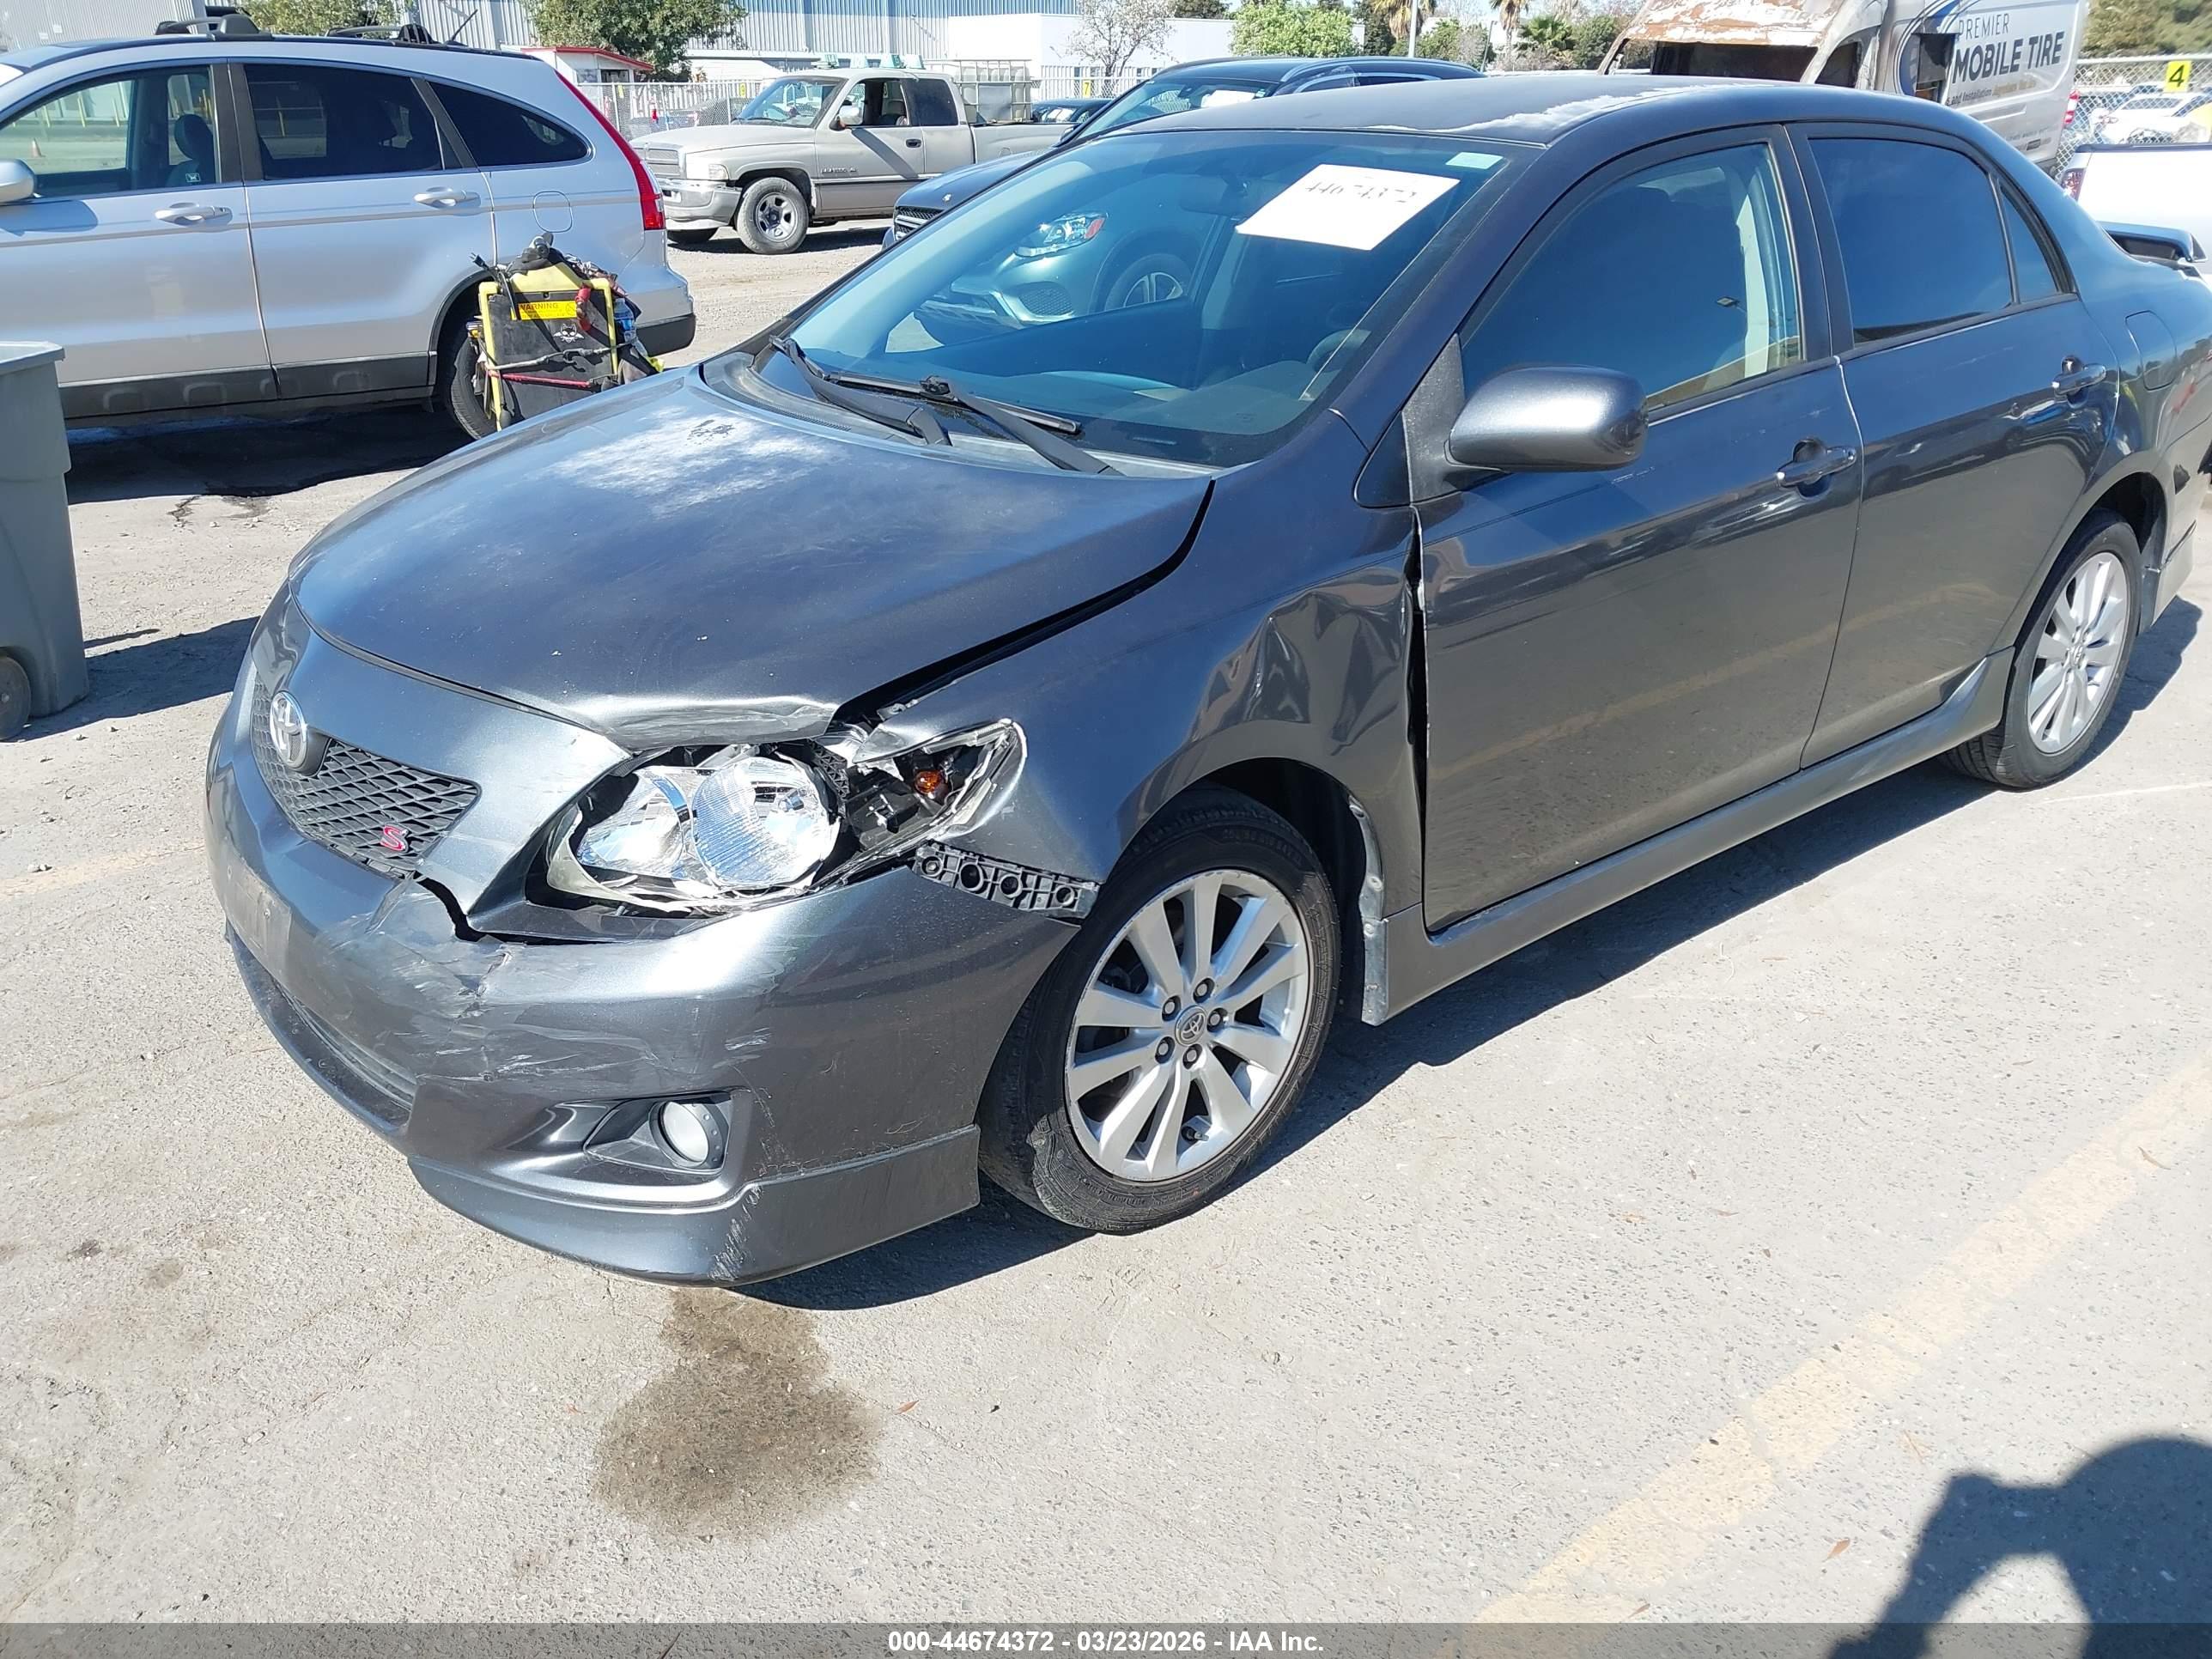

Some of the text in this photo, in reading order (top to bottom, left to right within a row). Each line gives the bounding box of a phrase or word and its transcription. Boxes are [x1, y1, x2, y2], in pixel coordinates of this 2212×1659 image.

[1957, 13, 2010, 41] PREMIER
[1952, 31, 2065, 84] MOBILE TIRE
[1084, 82, 1091, 95] 7
[2168, 64, 2185, 88] 4
[380, 824, 407, 852] S
